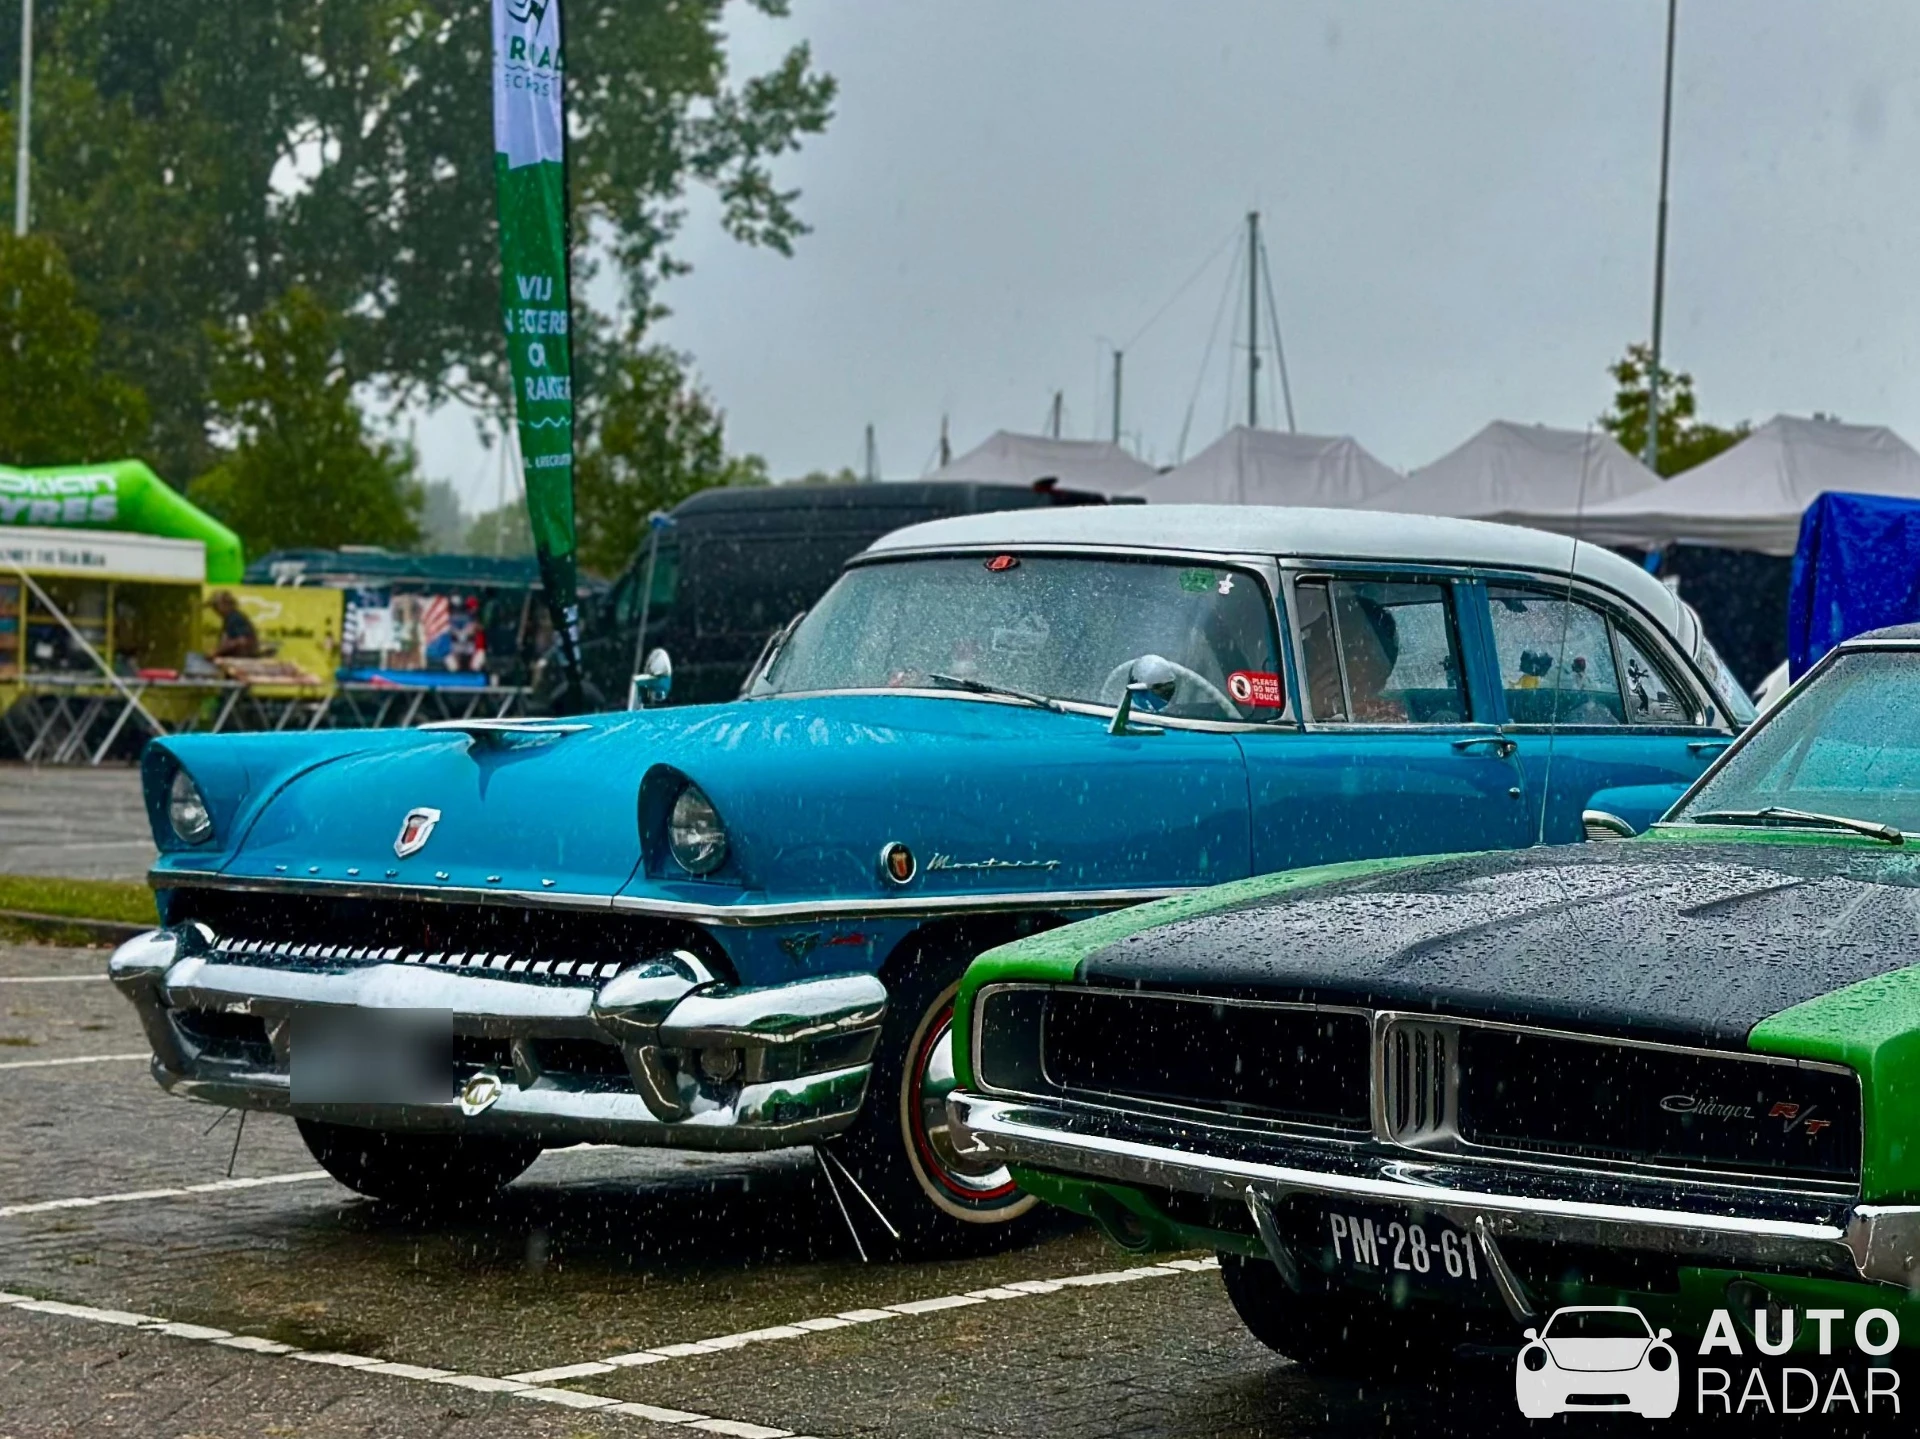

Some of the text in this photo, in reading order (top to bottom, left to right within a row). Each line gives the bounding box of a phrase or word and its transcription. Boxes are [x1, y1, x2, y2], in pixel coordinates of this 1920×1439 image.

[1252, 678, 1278, 687] PLEASE
[1255, 693, 1280, 701] TOUCH
[1659, 1095, 1831, 1134] Charger R/T
[1329, 1212, 1478, 1281] PM-28-61
